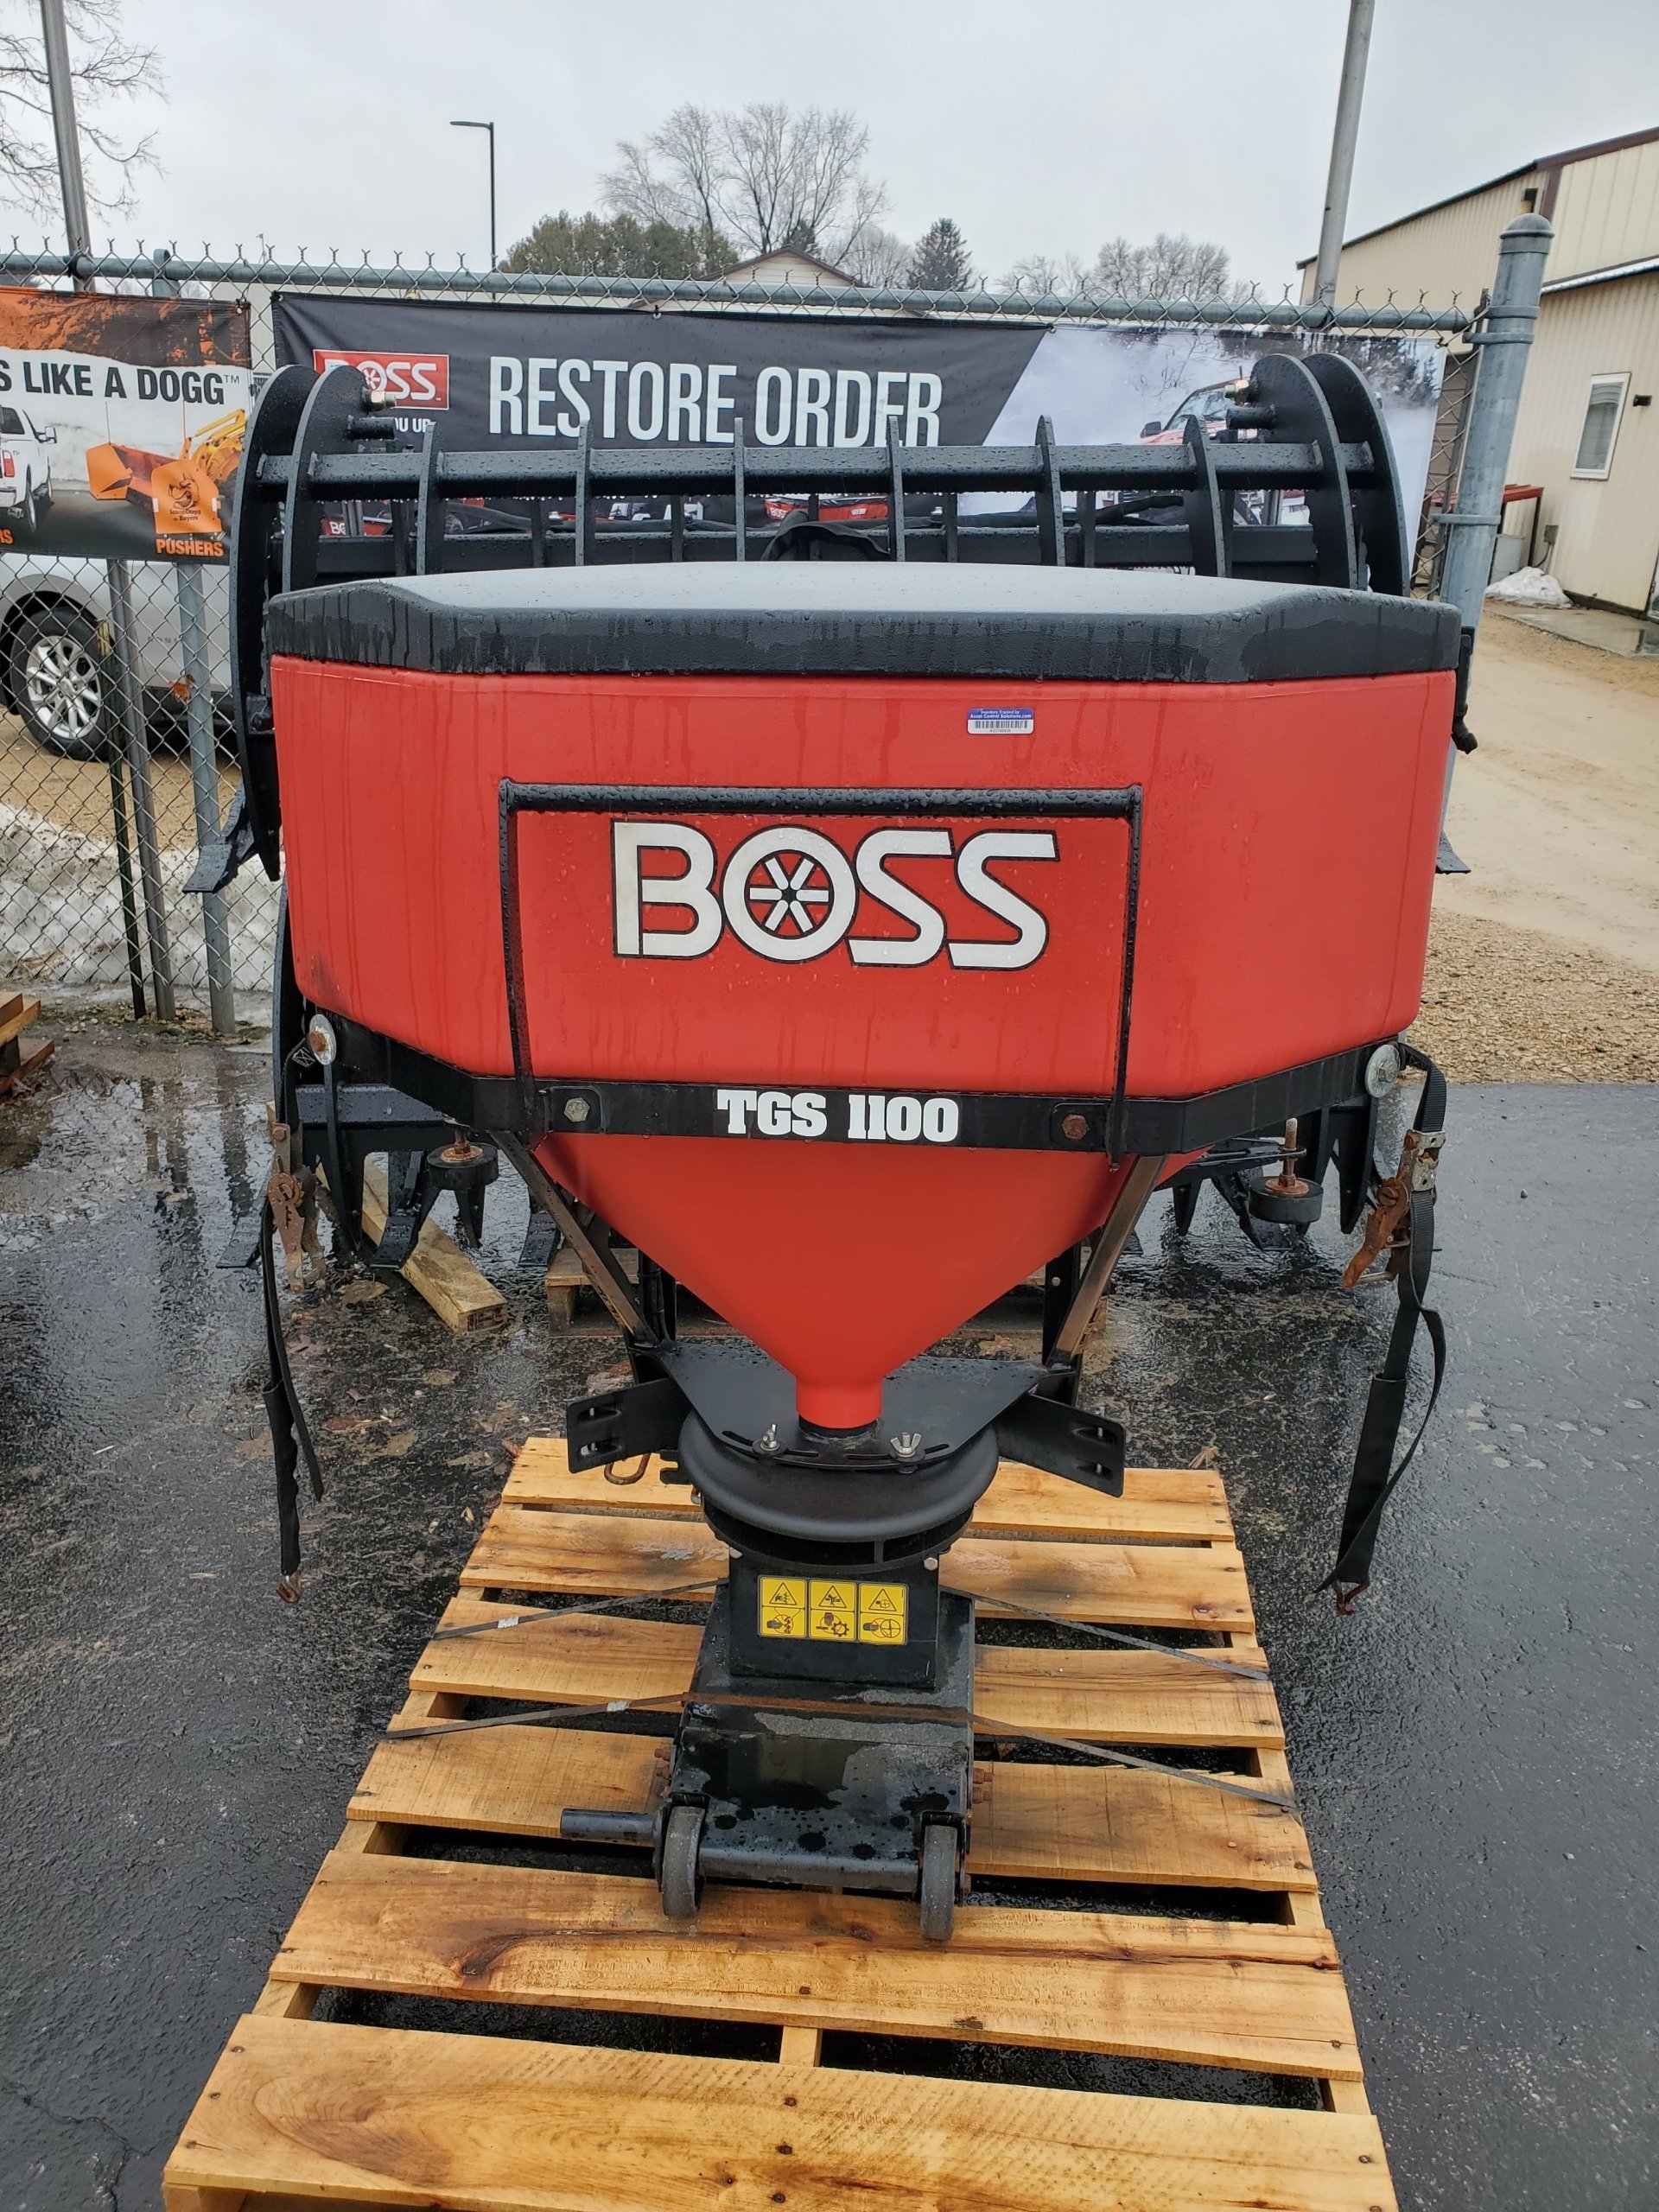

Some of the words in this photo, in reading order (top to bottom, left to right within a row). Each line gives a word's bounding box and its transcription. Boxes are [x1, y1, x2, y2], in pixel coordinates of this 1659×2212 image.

[23, 361, 93, 397] LIKE
[105, 366, 127, 399] A
[324, 359, 437, 400] OSS
[489, 356, 737, 443] RESTORE
[754, 366, 943, 448] ORDER
[156, 538, 224, 556] PUSHERS
[611, 820, 1059, 969] BOSS
[716, 1089, 828, 1137] TGS
[848, 1095, 959, 1143] 1100
